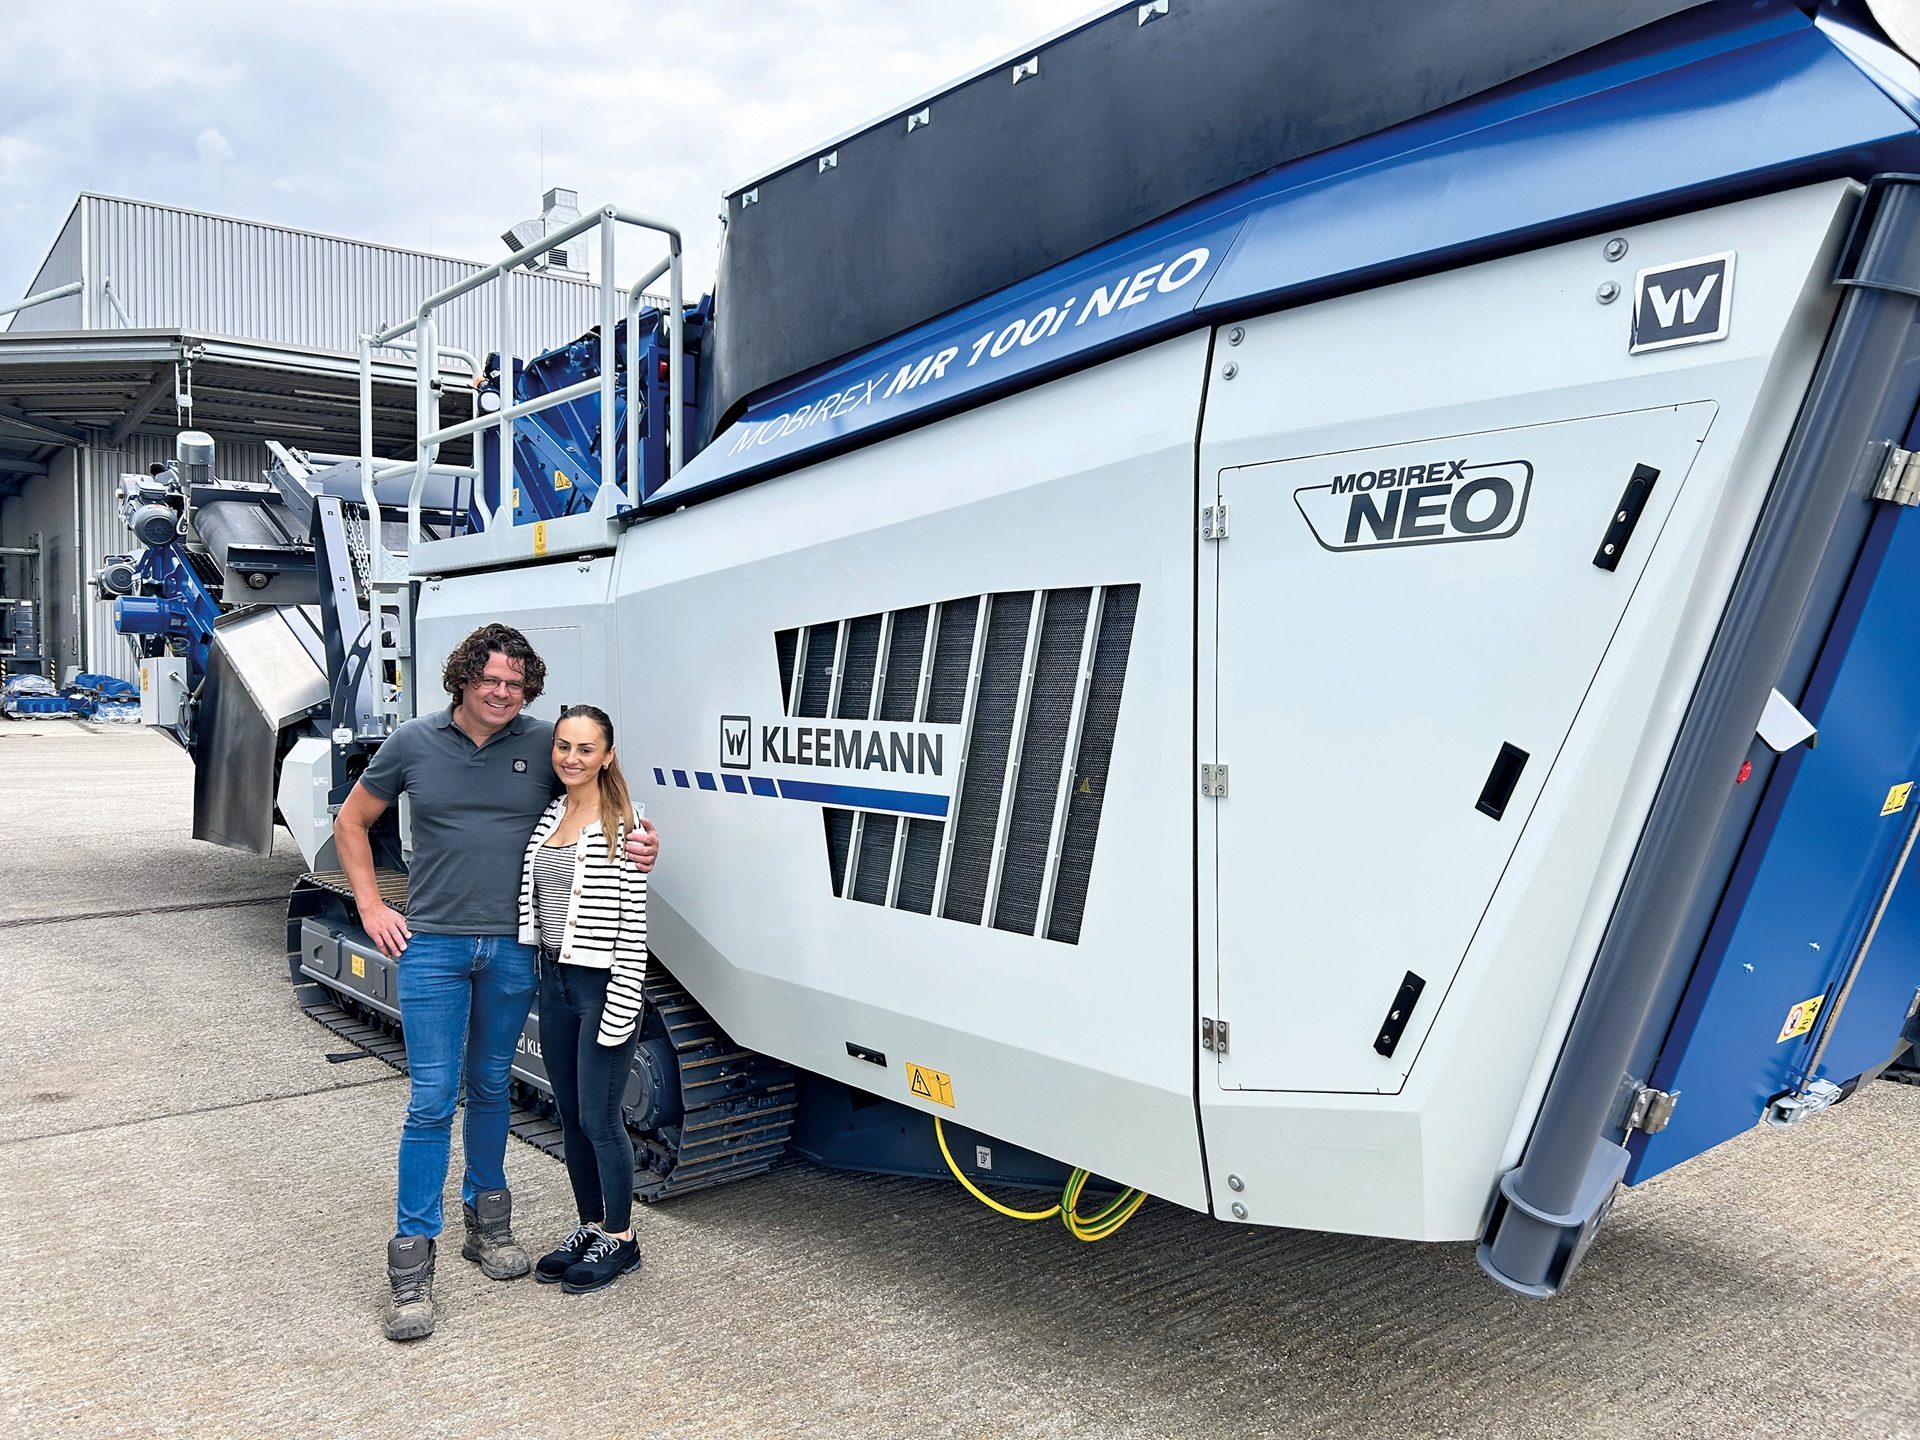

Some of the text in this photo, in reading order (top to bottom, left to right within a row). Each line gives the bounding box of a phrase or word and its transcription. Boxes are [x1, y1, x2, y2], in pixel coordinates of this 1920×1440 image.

[728, 247, 1210, 457] MOBIREX MR 100i NEO
[1331, 459, 1467, 495] MOBIREX
[1344, 476, 1514, 544] NEO
[762, 725, 943, 776] KLEEMANN
